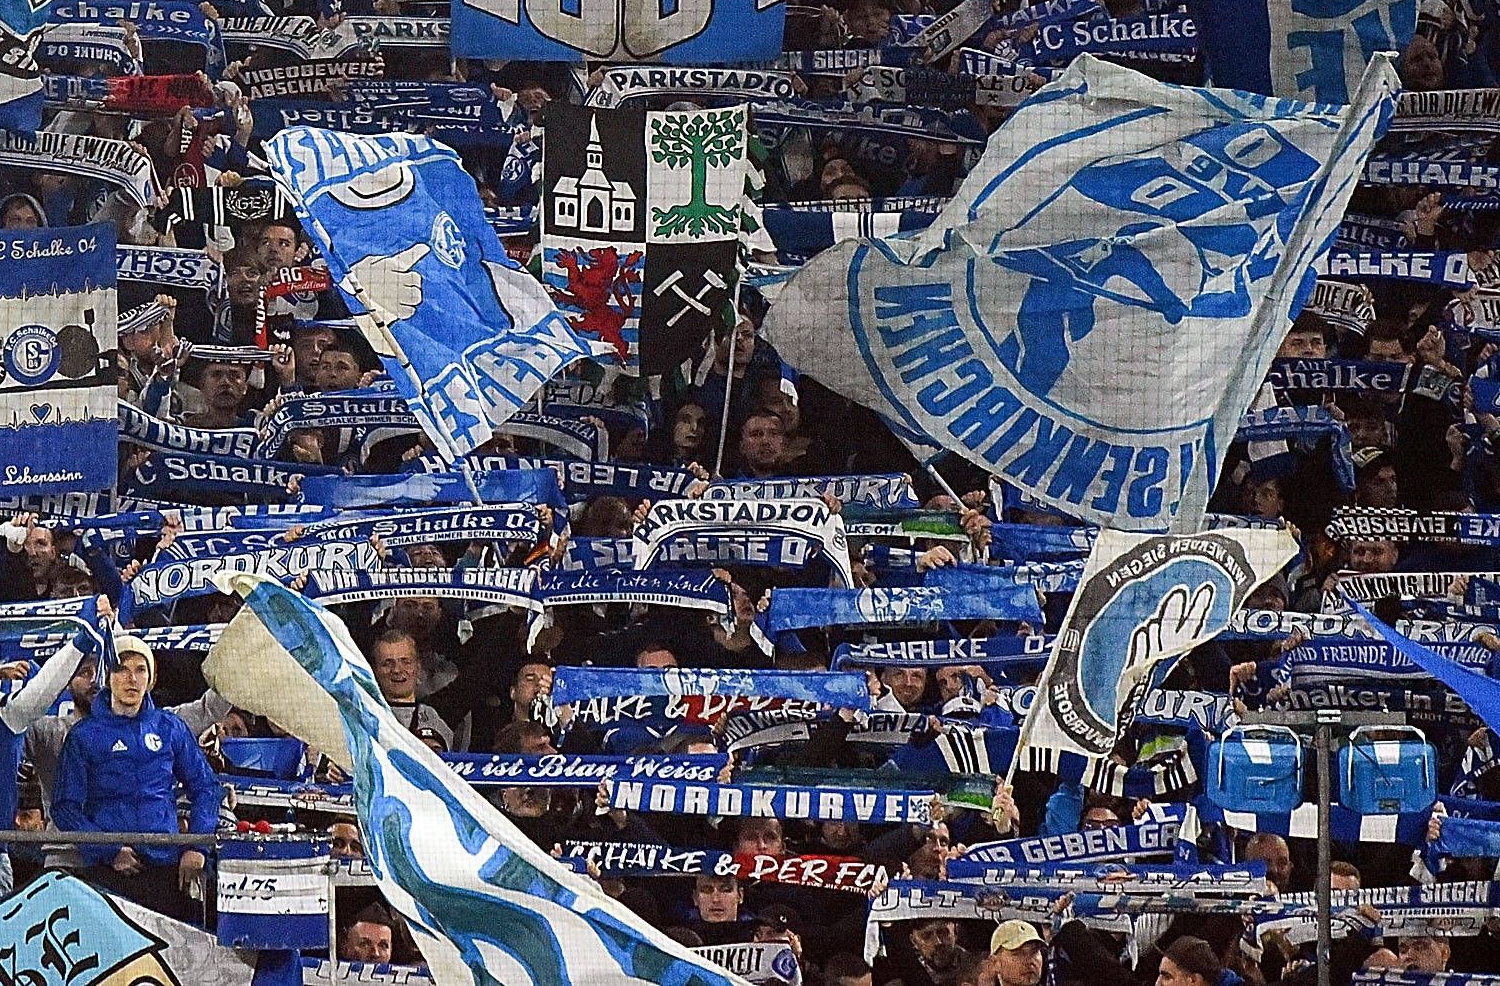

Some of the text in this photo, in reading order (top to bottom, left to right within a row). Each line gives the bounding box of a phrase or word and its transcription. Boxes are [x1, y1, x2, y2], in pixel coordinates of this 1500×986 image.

[1074, 19, 1197, 45] Schalke
[11, 239, 74, 260] Schalke
[77, 240, 96, 255] 04
[2, 466, 83, 487] Lebenssinn
[373, 511, 498, 535] Schalke
[634, 500, 835, 544] PARKSTADION
[463, 569, 536, 592] SIEGEN
[1324, 645, 1388, 664] FREUNDE
[486, 758, 522, 777] ist
[531, 755, 616, 780] Blau
[628, 757, 715, 782] Weiss
[615, 781, 914, 822] NORDKURVE
[1023, 828, 1128, 864] GEBEN
[750, 854, 822, 884] DER
